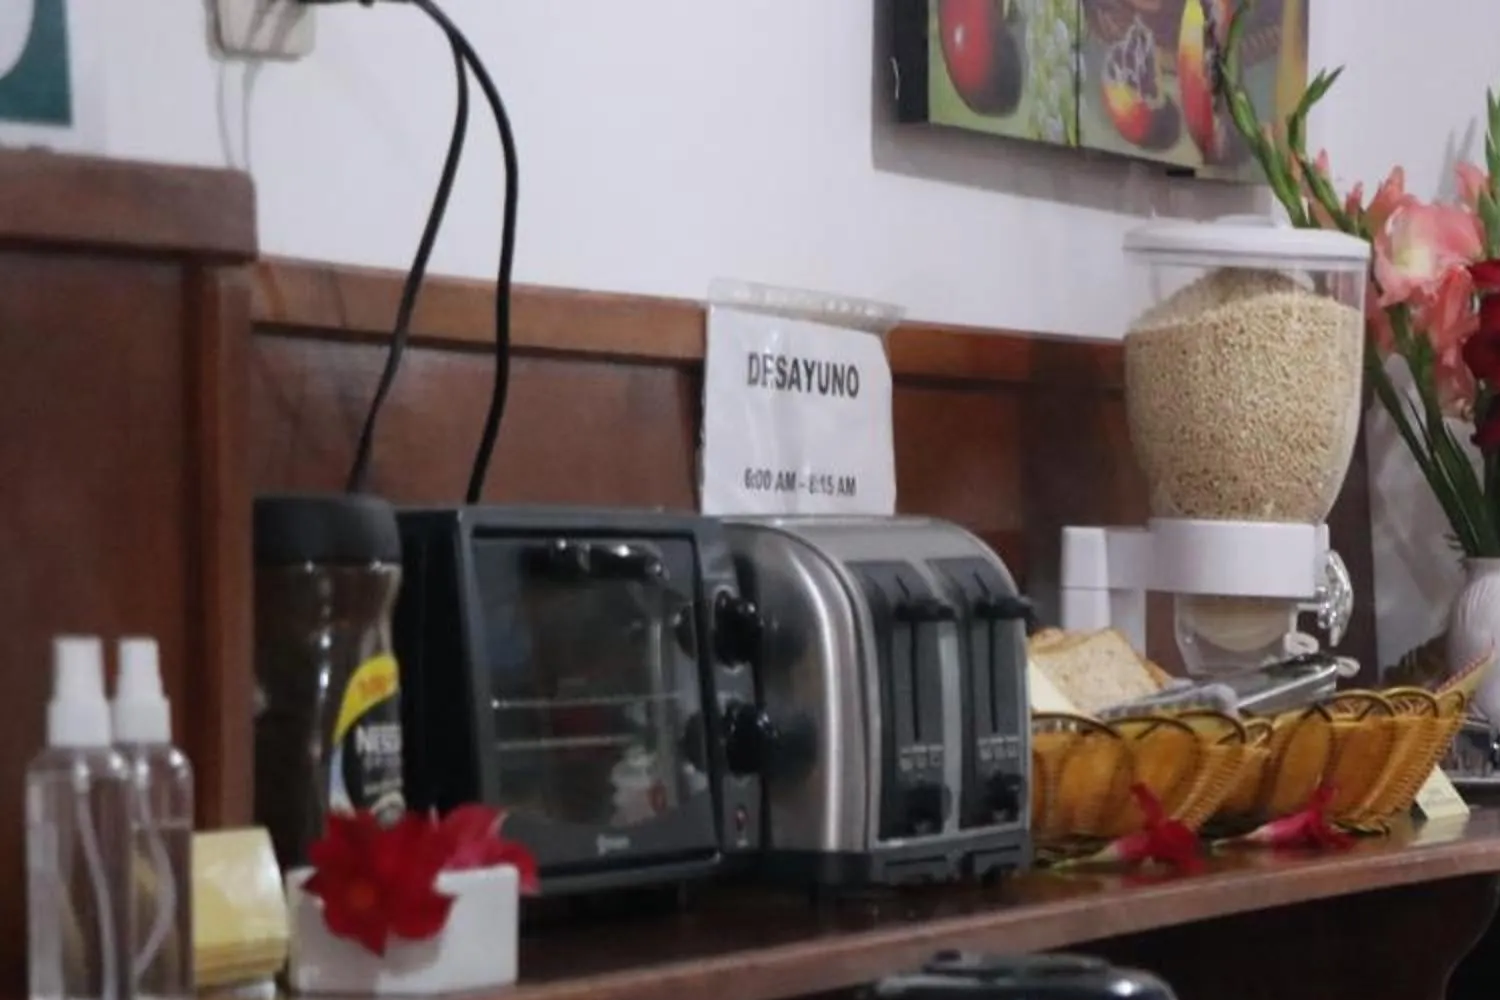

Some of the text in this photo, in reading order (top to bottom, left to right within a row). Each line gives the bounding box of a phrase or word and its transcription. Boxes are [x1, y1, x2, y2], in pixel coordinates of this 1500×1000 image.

[746, 353, 860, 399] DESAYUNO
[774, 470, 797, 492] AM
[837, 476, 857, 497] AM
